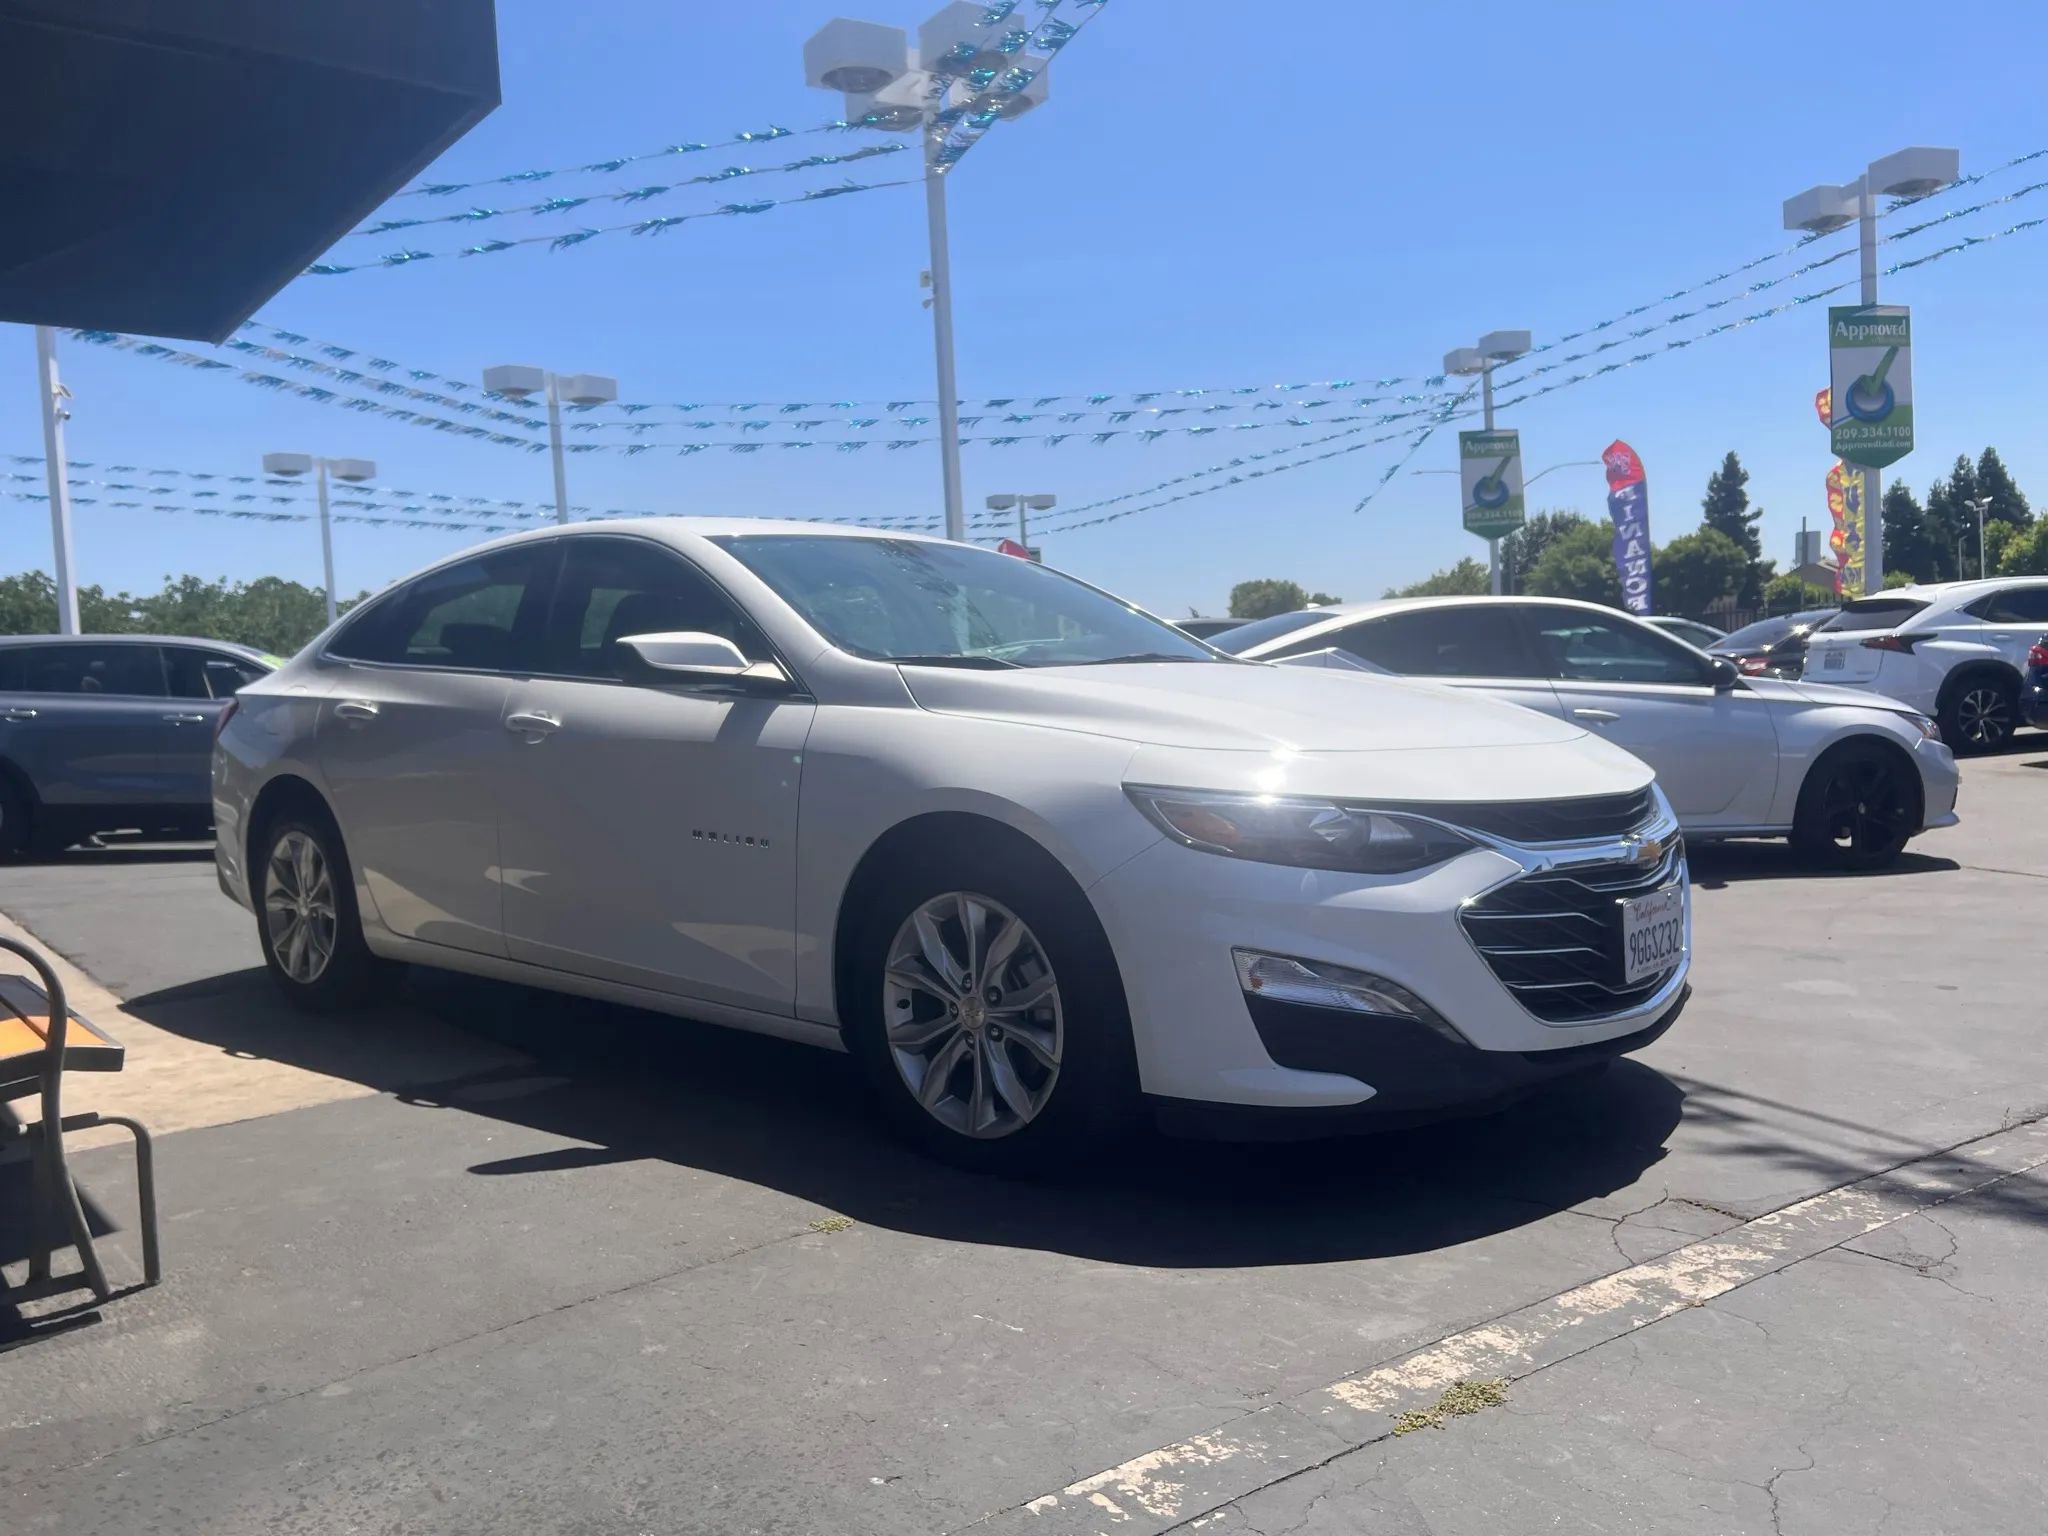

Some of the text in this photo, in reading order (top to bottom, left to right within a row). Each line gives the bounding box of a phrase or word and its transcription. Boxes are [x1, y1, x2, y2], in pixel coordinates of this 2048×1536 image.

[1835, 319, 1907, 341] Approved
[1836, 426, 1911, 440] 209.334.1100
[1629, 918, 1680, 970] 9GGS232
